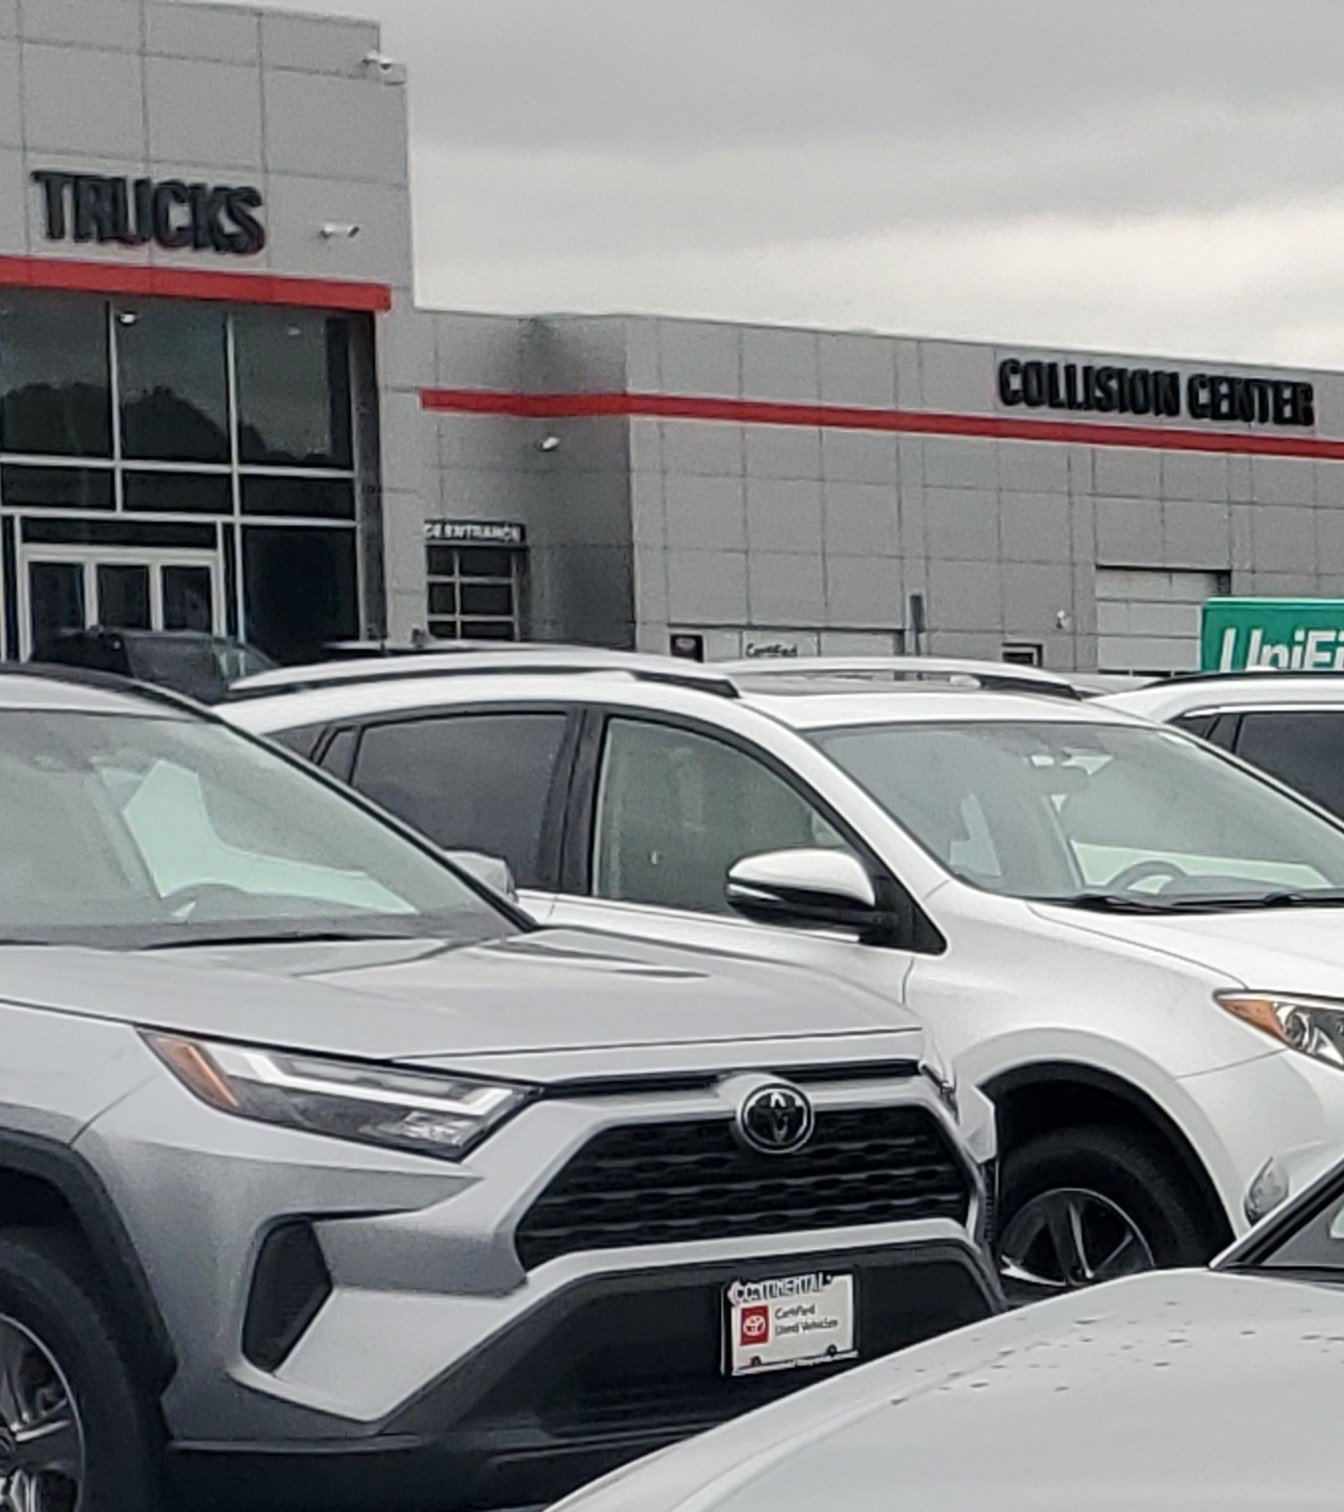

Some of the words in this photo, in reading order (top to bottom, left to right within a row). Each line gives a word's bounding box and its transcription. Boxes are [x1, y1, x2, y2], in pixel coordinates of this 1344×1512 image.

[31, 169, 266, 256] TRUCKS
[999, 358, 1180, 416] COLLISION
[1187, 373, 1315, 426] CENTER
